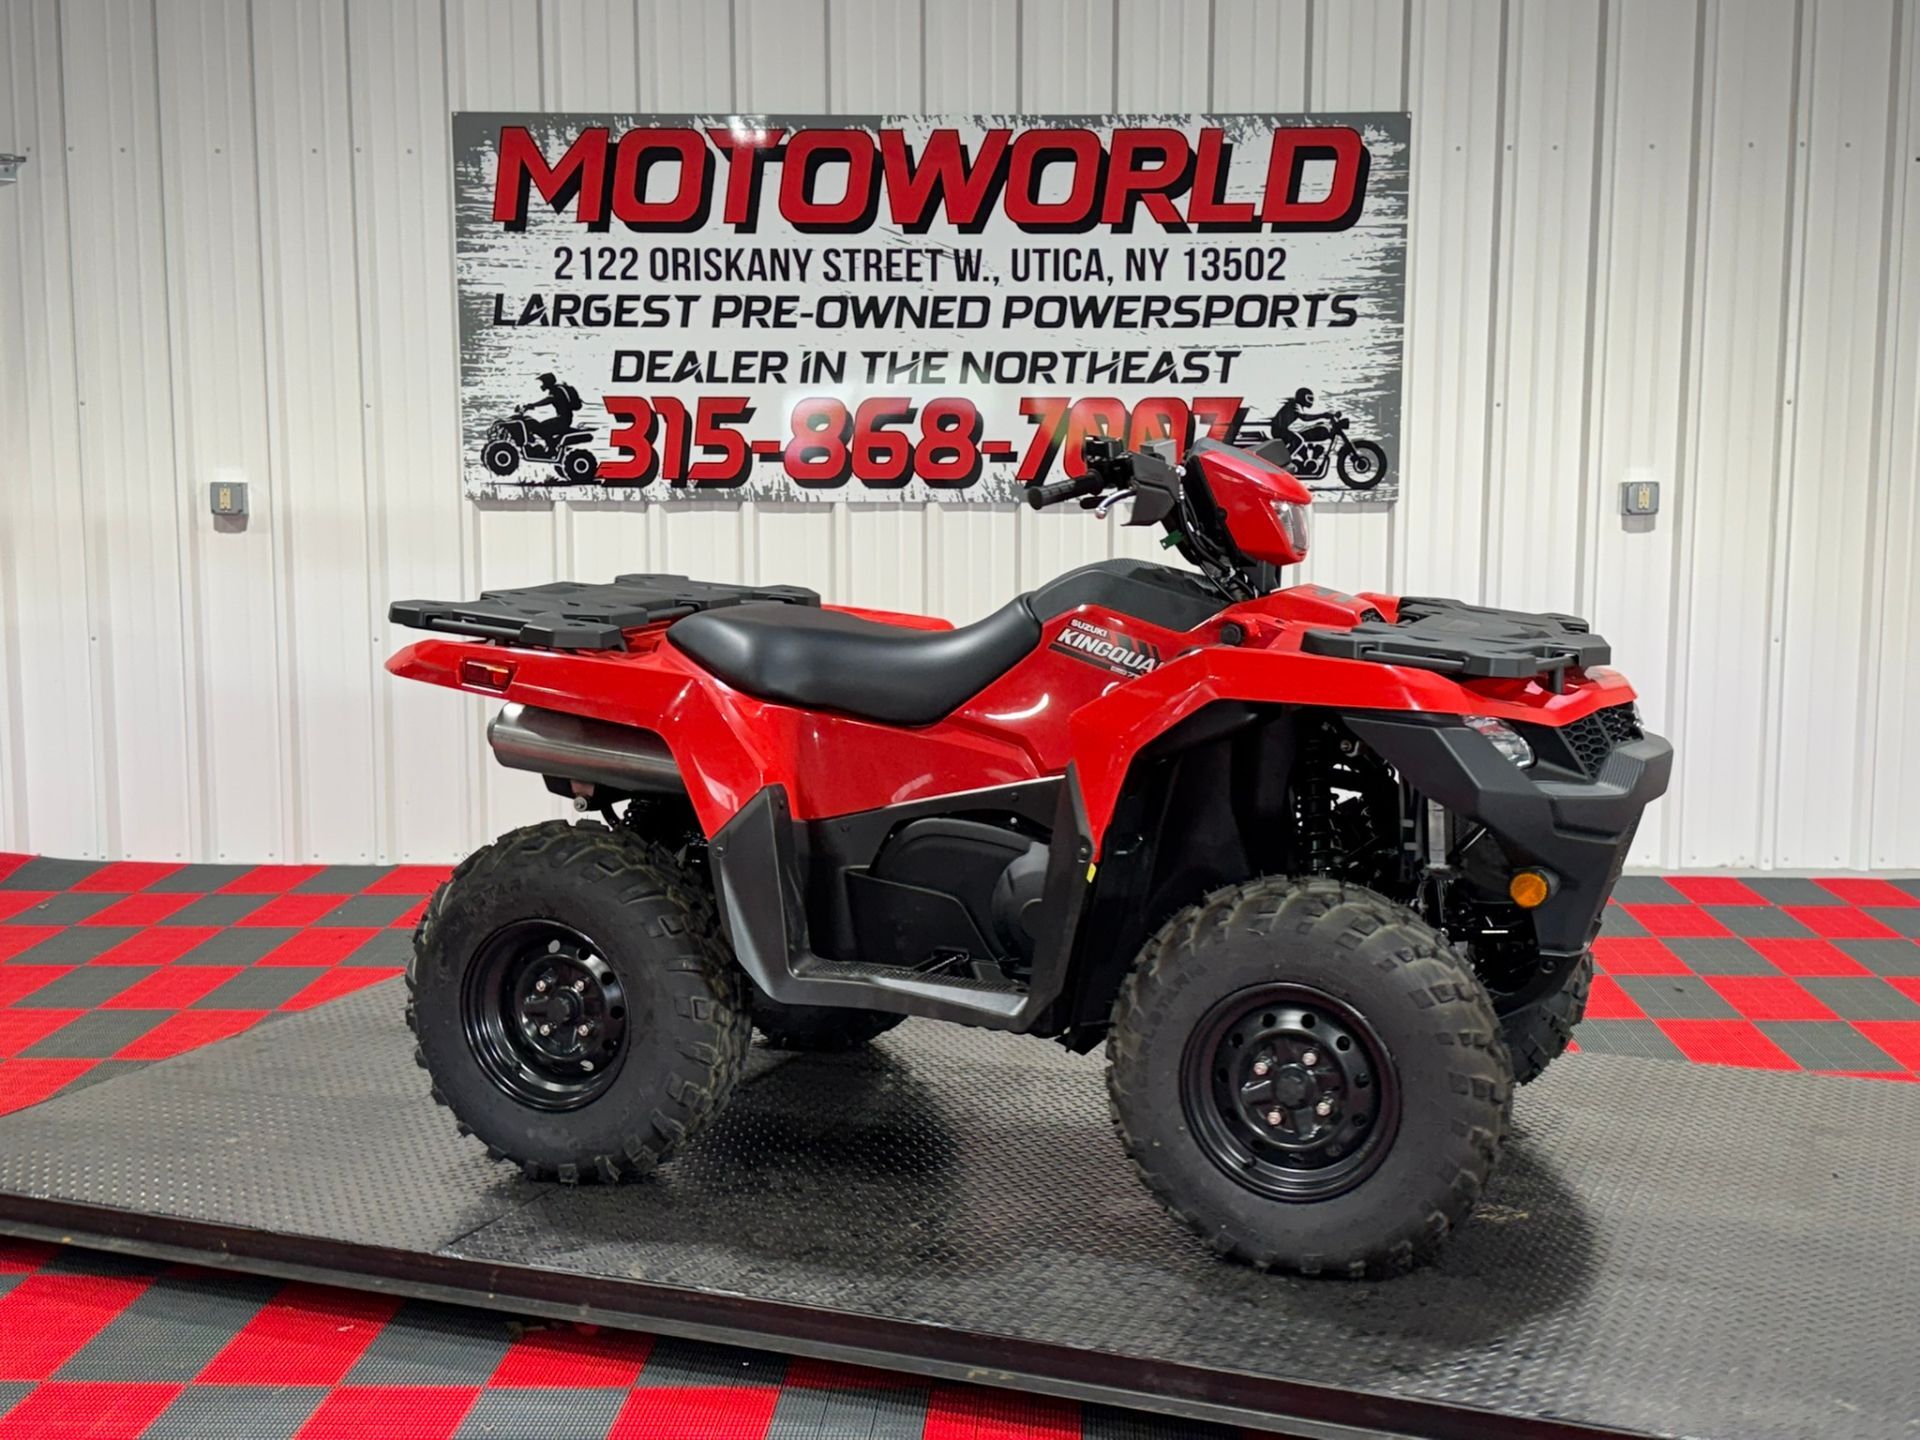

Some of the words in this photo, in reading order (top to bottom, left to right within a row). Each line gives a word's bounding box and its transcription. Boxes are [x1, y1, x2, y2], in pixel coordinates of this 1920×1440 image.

[493, 127, 1370, 233] MOTOWORLD
[554, 246, 639, 281] 2122
[649, 247, 813, 282] ORISKANY
[823, 247, 943, 282] STREET
[953, 248, 1000, 286] W.,
[1011, 248, 1114, 286] UTICA,
[1125, 247, 1170, 281] NY
[1184, 247, 1287, 281] 13502
[493, 293, 701, 327] LARGEST
[712, 295, 991, 328] PRE-OWNED
[1002, 294, 1361, 328] POWERSPORTS
[611, 350, 789, 383] DEALER
[800, 350, 847, 383] IN
[861, 350, 949, 384] THE
[959, 350, 1242, 384] NORTHEAST
[1071, 619, 1109, 638] SUZUKI
